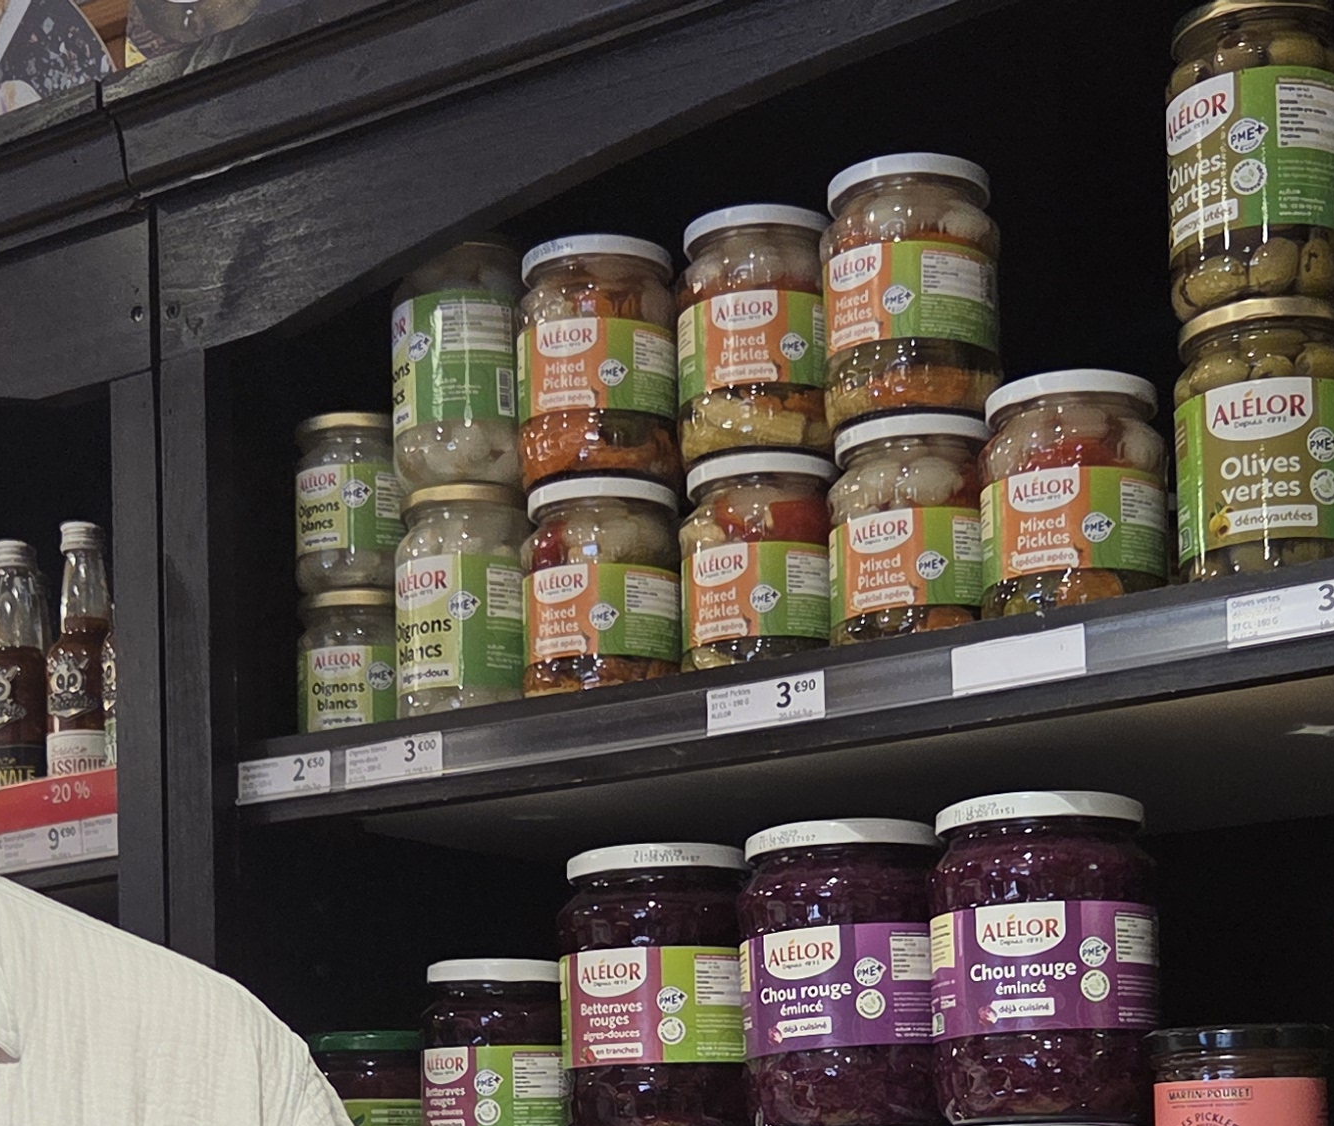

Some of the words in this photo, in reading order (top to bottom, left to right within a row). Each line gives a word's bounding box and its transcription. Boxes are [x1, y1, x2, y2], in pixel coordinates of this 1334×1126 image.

[1169, 153, 1222, 194] Olives
[835, 290, 869, 310] Mixed
[834, 306, 872, 328] Pickles
[723, 332, 766, 349] Mixed
[720, 348, 769, 363] Pickles
[1220, 453, 1301, 480] Olives
[1221, 477, 1301, 503] vertes
[301, 518, 334, 531] blancs
[1019, 514, 1065, 531] Mixed
[1017, 529, 1071, 550] Pickles
[700, 587, 736, 605] Mixed
[698, 600, 740, 620] Pickles
[312, 682, 365, 696] Oignons
[776, 682, 791, 708] 3
[794, 679, 816, 692] €90
[317, 699, 358, 711] blancs
[981, 915, 1059, 943] ALÉLOR
[581, 961, 641, 986] ALÉLOR
[970, 963, 1017, 981] Chou
[1021, 959, 1077, 979] rouge
[580, 1001, 643, 1016] Betteraves
[780, 998, 823, 1016] émincé
[589, 1013, 629, 1028] rouges
